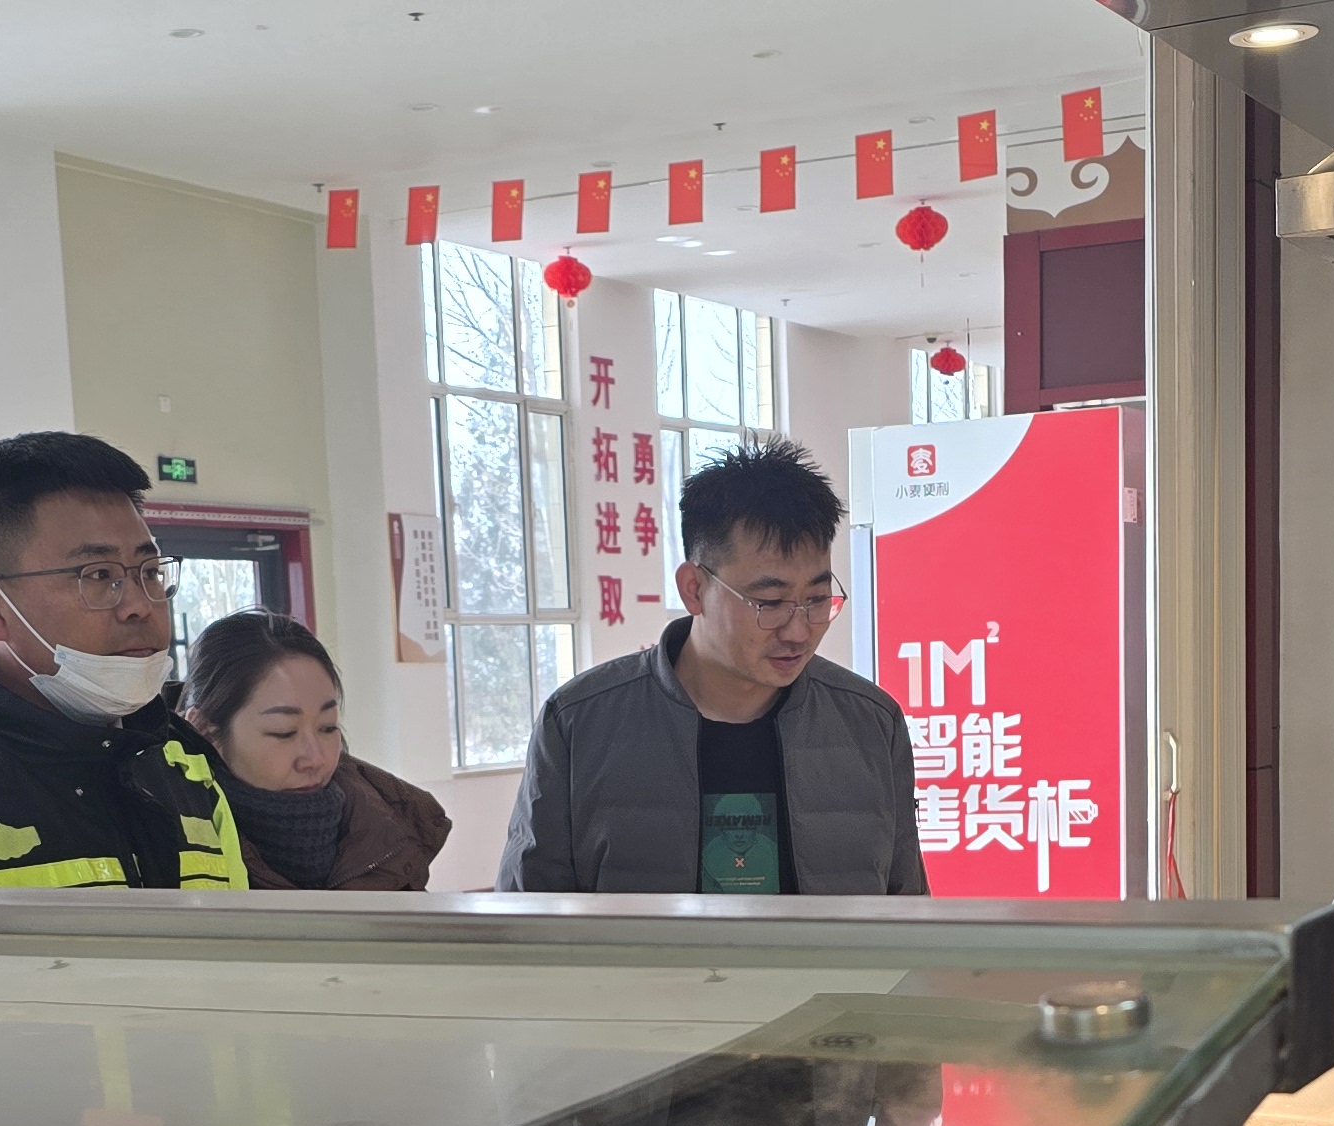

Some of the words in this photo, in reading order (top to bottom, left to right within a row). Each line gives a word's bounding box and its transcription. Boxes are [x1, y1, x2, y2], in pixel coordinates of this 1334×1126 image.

[590, 356, 624, 626] 开拓进取
[632, 432, 660, 650] 勇争一
[895, 481, 950, 500] 小麦便利
[904, 712, 1022, 778] 智能
[914, 779, 1099, 893] 售货柜
